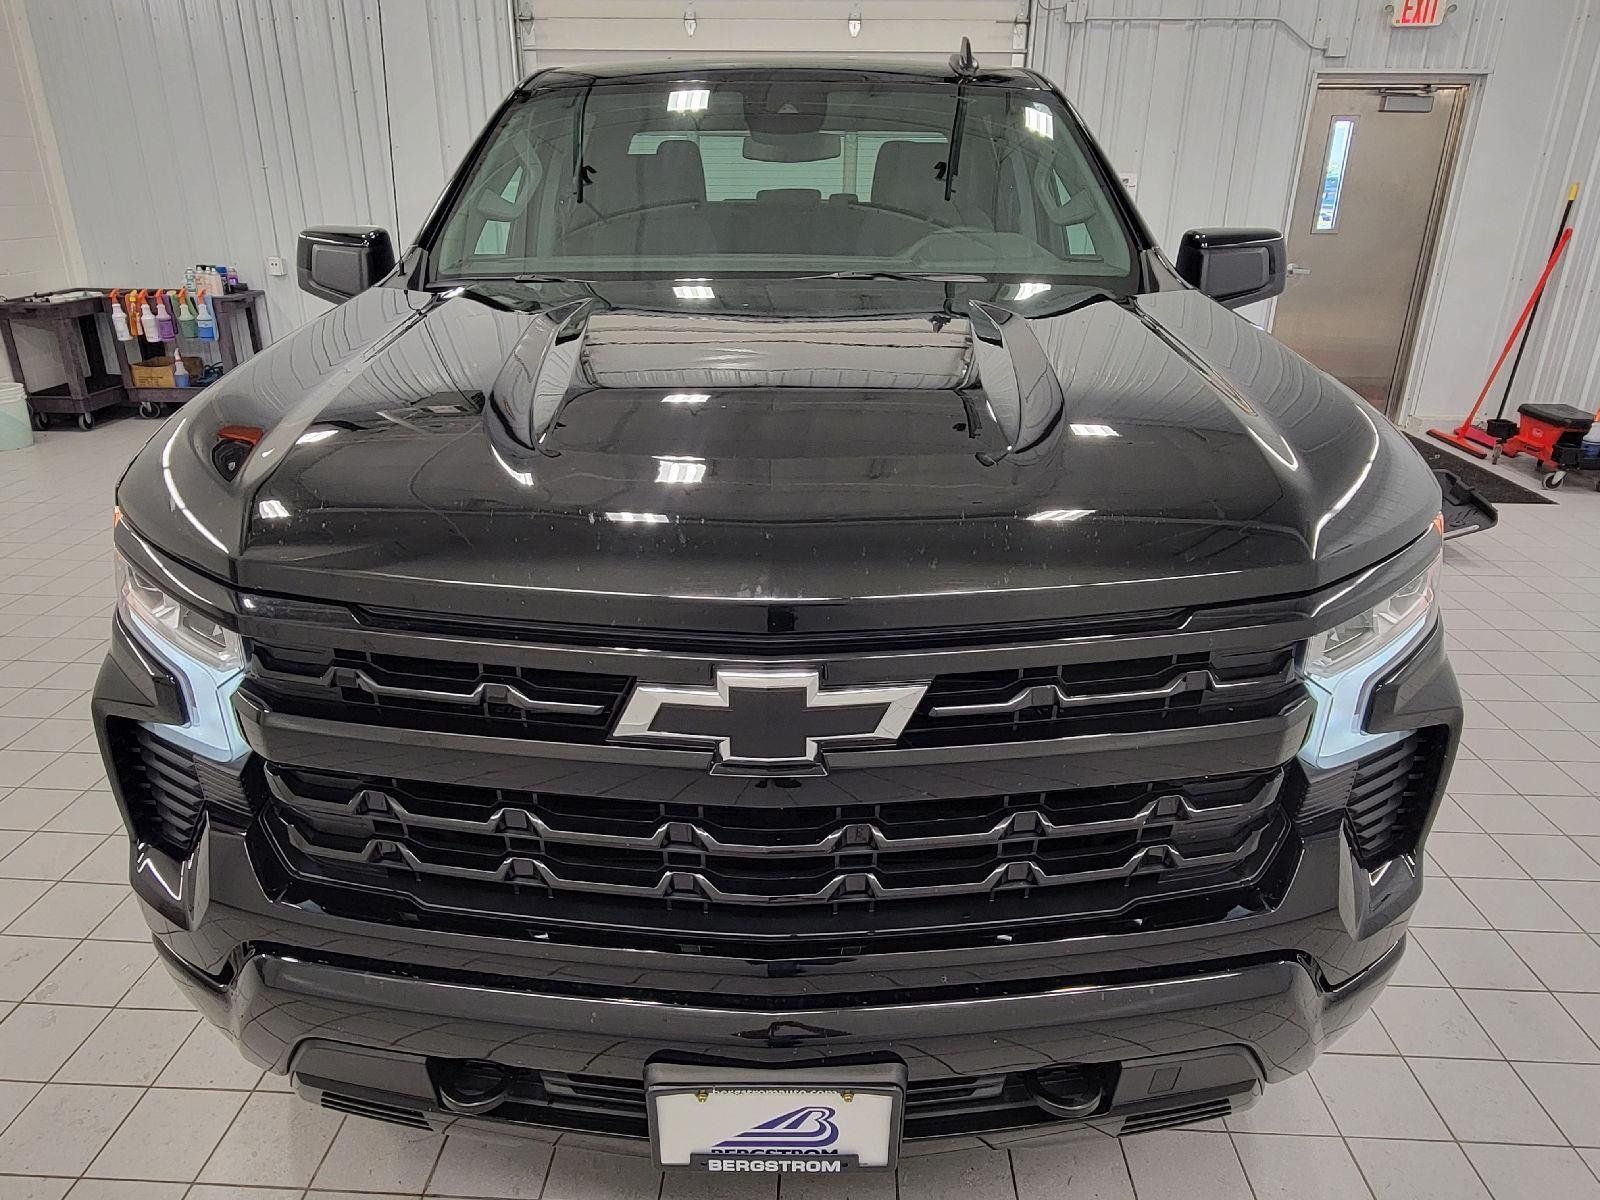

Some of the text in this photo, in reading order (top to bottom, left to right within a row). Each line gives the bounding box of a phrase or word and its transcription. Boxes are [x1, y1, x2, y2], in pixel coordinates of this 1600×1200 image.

[1400, 0, 1439, 24] EXIT
[713, 1086, 838, 1095] bergstromauto.com
[708, 1159, 841, 1172] BERGSTROM
